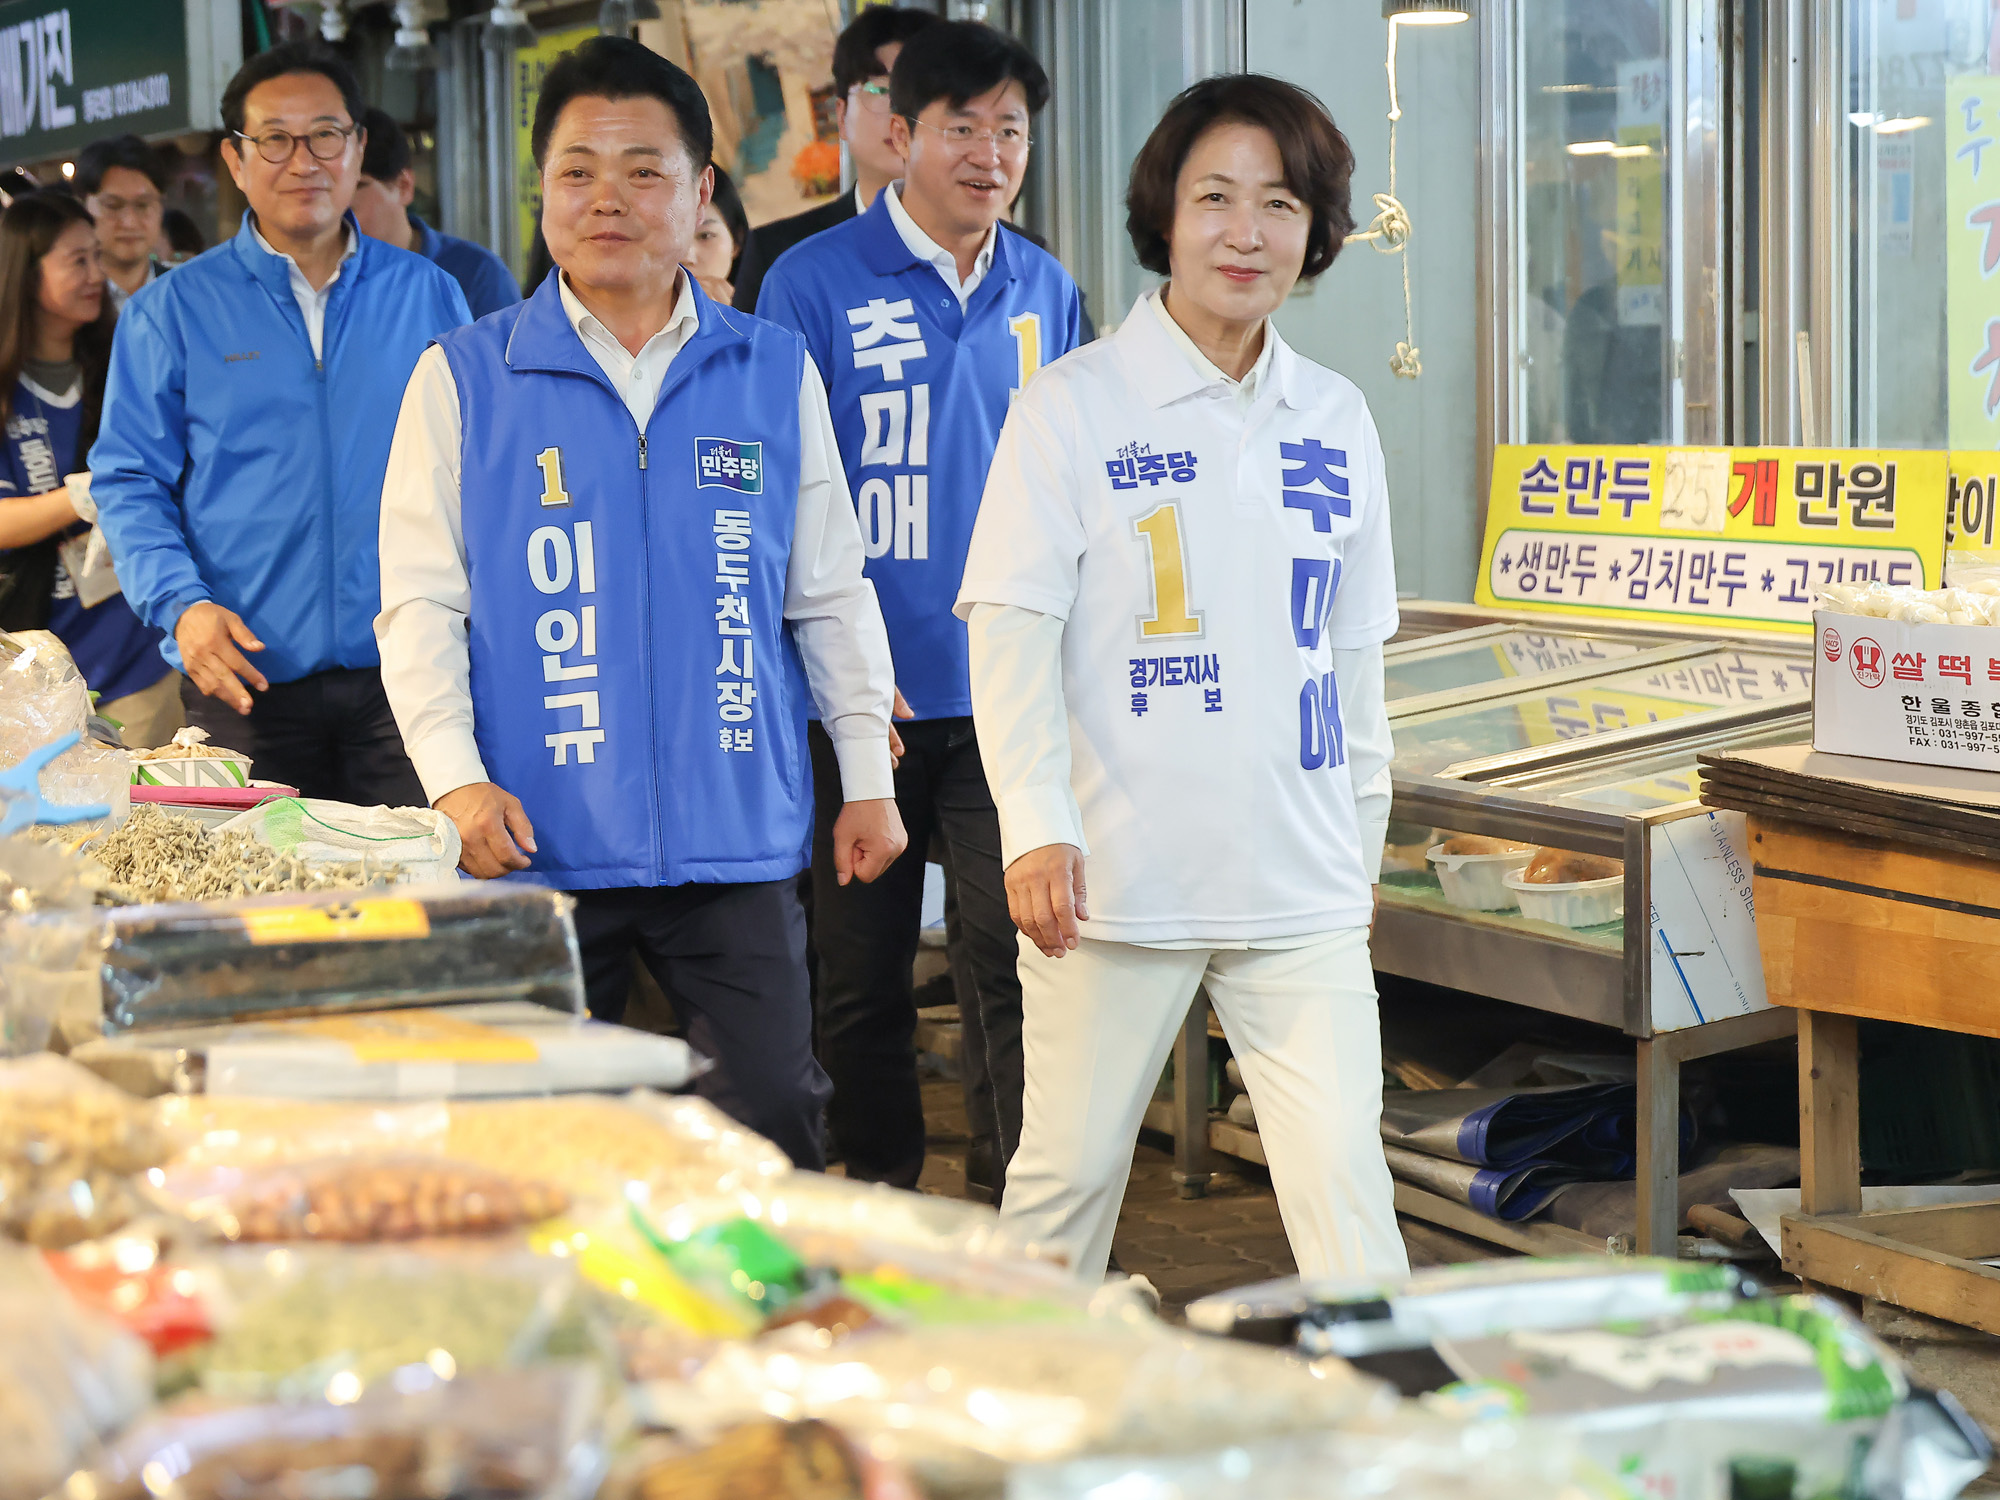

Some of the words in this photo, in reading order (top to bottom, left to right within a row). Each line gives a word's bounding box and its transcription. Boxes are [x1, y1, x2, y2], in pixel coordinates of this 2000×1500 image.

[1008, 311, 1042, 402] 1
[846, 297, 930, 559] 추미애
[1116, 441, 1151, 459] 더불어
[536, 446, 570, 507] 1
[701, 456, 759, 480] 민주당
[1106, 451, 1198, 490] 민주당
[1519, 457, 1651, 518] 손만두
[1660, 462, 1715, 525] 25
[1727, 459, 1780, 527] 개
[1795, 462, 1895, 529] 만원
[1132, 501, 1204, 640] 1
[713, 509, 757, 722] 동두천시장
[1280, 438, 1351, 771] 추미애
[527, 520, 605, 766] 이인규
[1129, 653, 1220, 688] 경기도지사
[718, 727, 753, 752] 후보
[1905, 714, 1928, 725] 경기도
[1930, 716, 1952, 728] 김포시
[1907, 726, 1928, 736] TEL
[1909, 737, 1931, 747] FAX
[1710, 822, 1745, 884] STAINLESS
